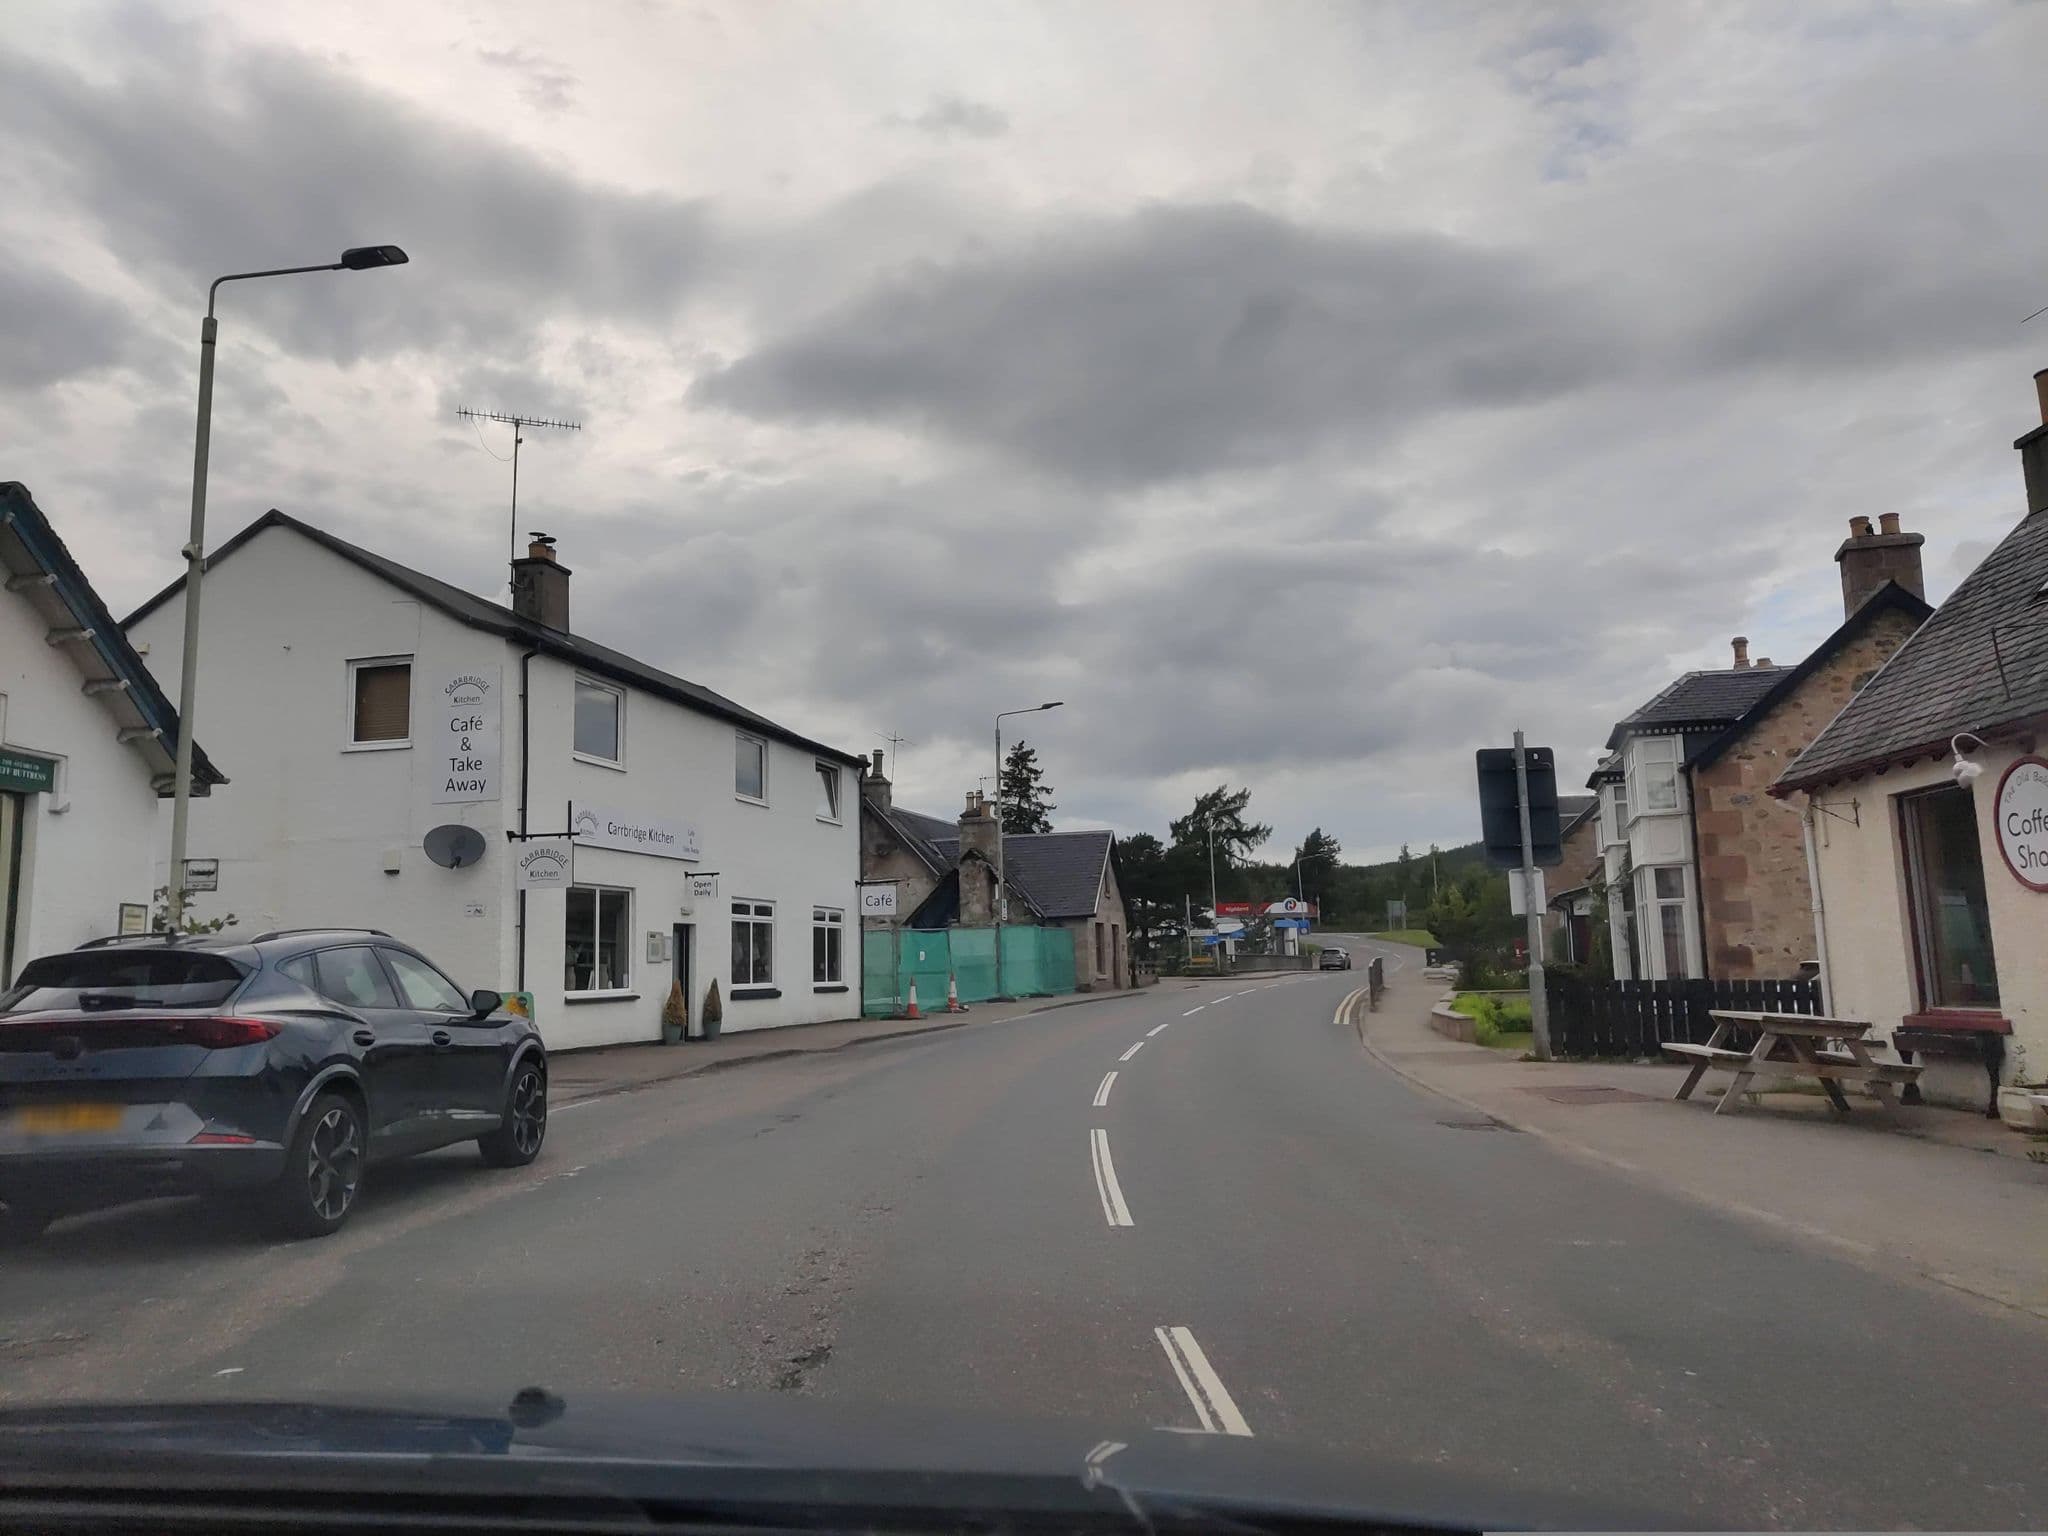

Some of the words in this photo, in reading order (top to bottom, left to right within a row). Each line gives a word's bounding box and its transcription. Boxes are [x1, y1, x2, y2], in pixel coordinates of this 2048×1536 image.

[444, 675, 490, 694] CARRBRIDGE
[453, 695, 481, 704] Kitchen
[450, 715, 483, 732] Café
[460, 736, 472, 751] &
[450, 757, 482, 772] Take
[445, 778, 486, 793] Away
[608, 821, 647, 843] Carrbridge
[648, 827, 675, 845] Kitchen
[520, 848, 568, 868] CARRBRIDGE
[529, 870, 559, 878] Kitchen
[694, 881, 712, 889] Open
[694, 889, 711, 897] Daily
[865, 894, 893, 907] Café
